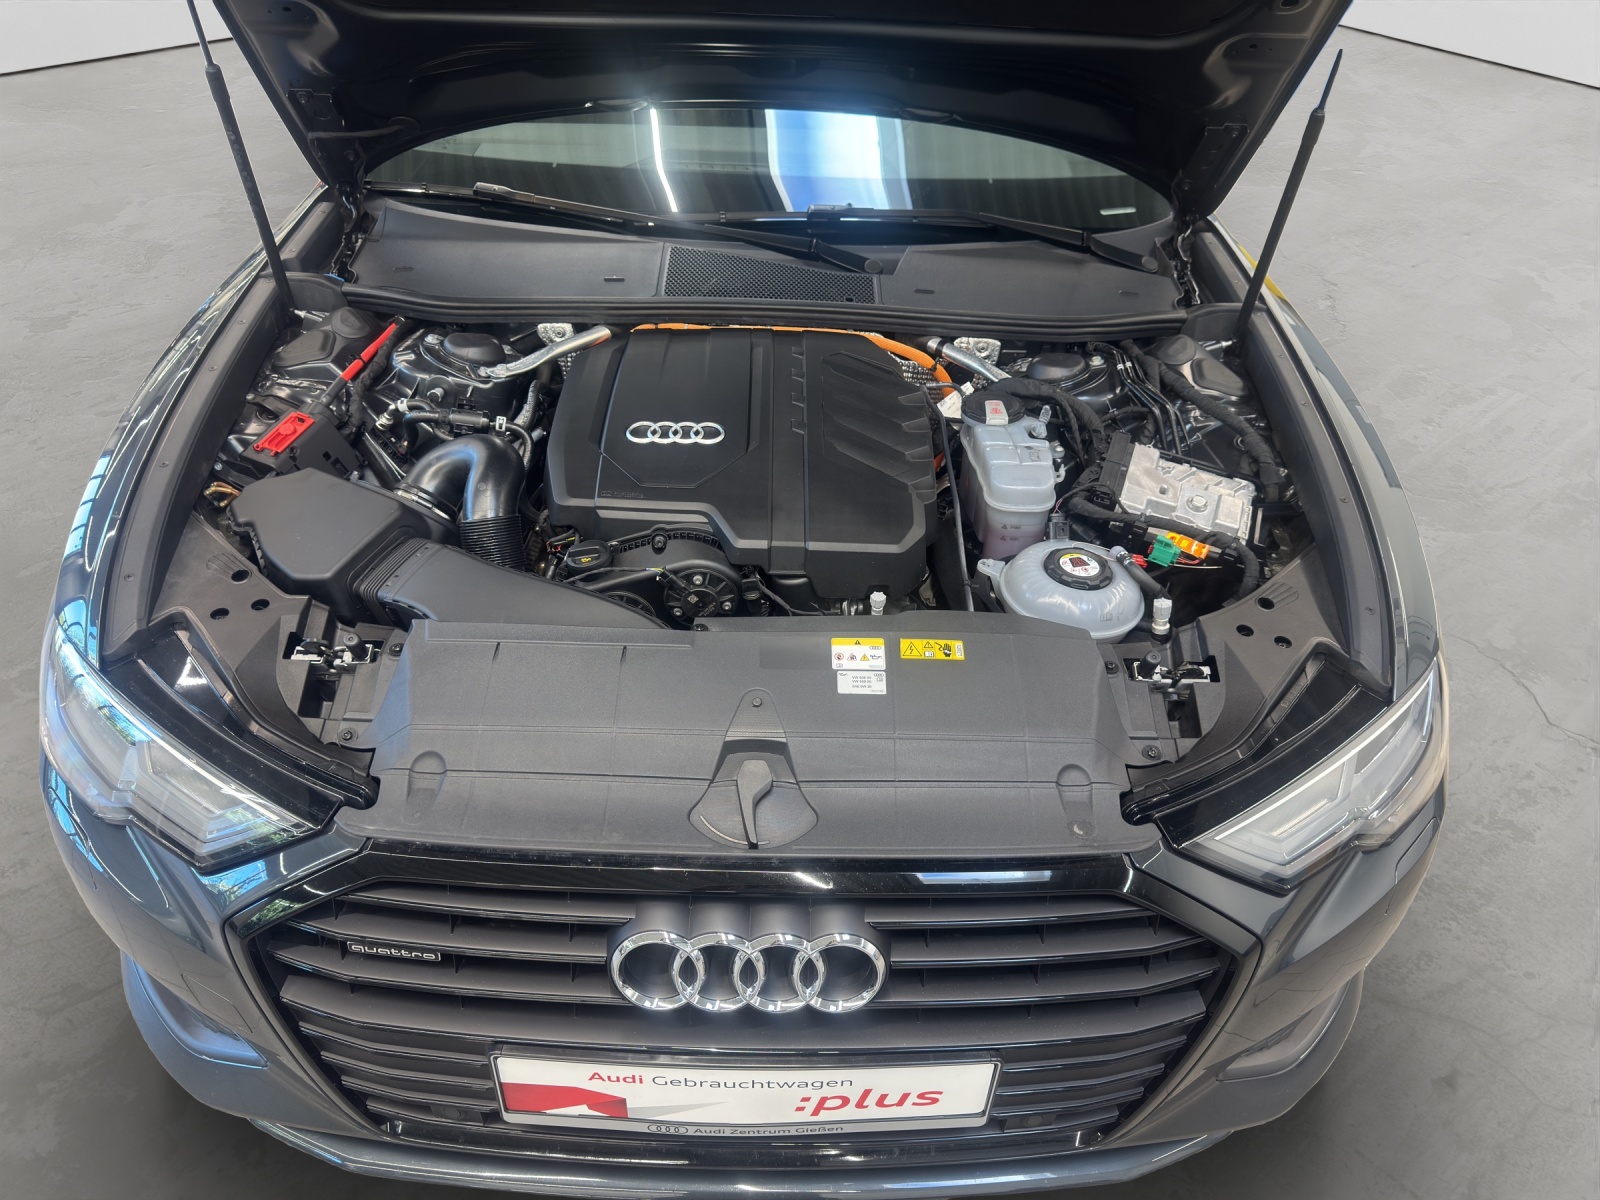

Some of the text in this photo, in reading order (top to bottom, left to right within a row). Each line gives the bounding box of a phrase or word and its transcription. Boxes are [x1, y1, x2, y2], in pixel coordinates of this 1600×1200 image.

[352, 945, 435, 959] quattro
[588, 1072, 853, 1090] Audi Gebrauchtwagen
[794, 1089, 944, 1116] :plus
[795, 1126, 844, 1134] Gießen
